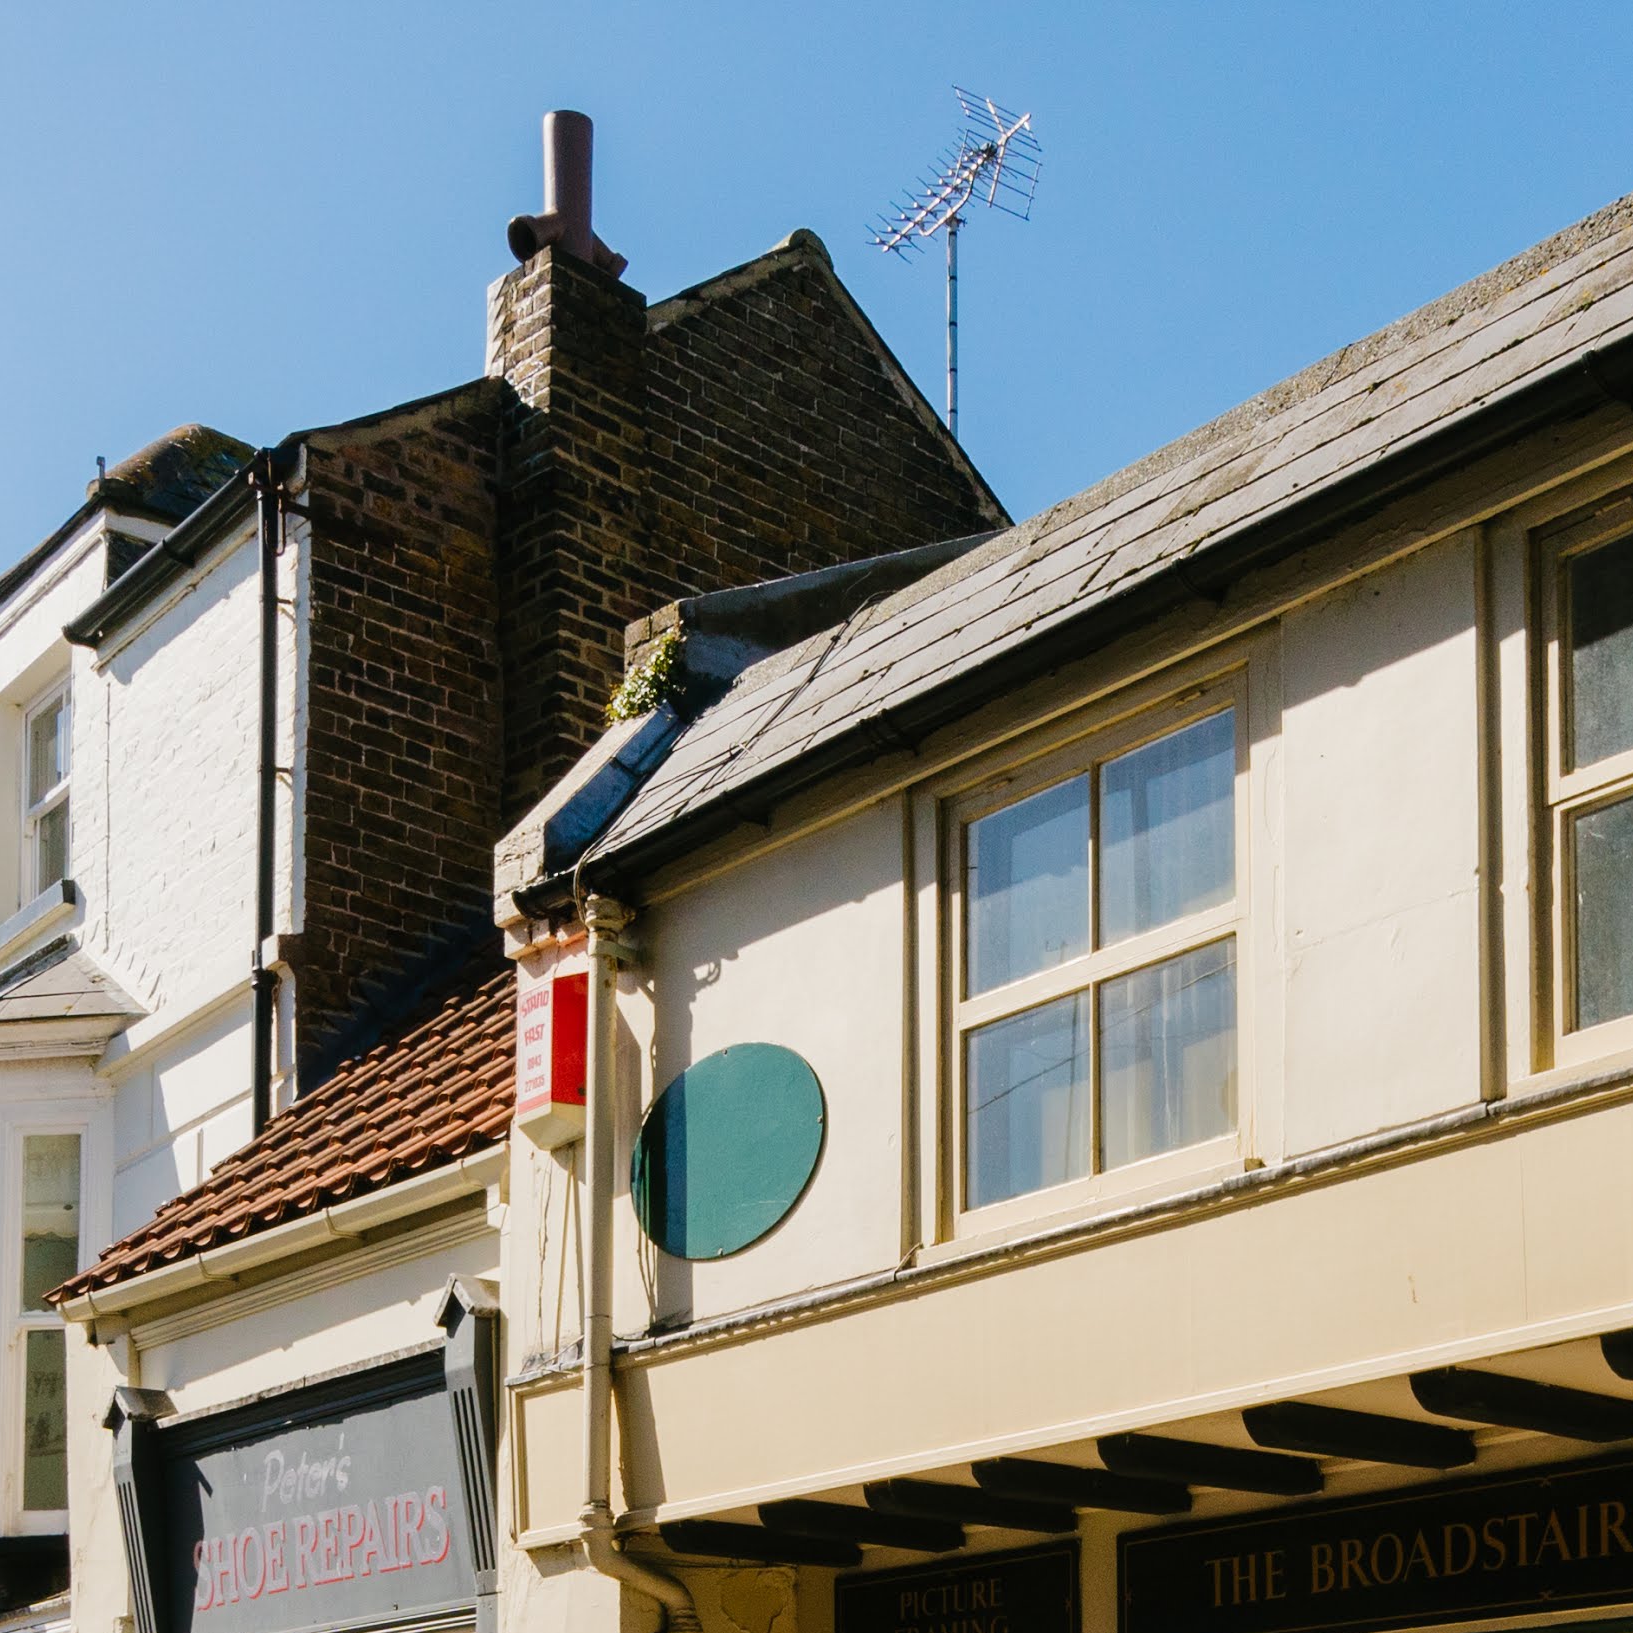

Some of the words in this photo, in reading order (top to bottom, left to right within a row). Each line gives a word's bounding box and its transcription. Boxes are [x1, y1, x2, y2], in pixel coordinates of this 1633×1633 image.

[524, 1024, 545, 1046] FAST
[261, 1432, 351, 1513] Peter's
[193, 1520, 290, 1612] SHOE
[292, 1485, 451, 1589] REPAIRS
[899, 1578, 1003, 1621] PICTURE
[1205, 1549, 1287, 1608] THE
